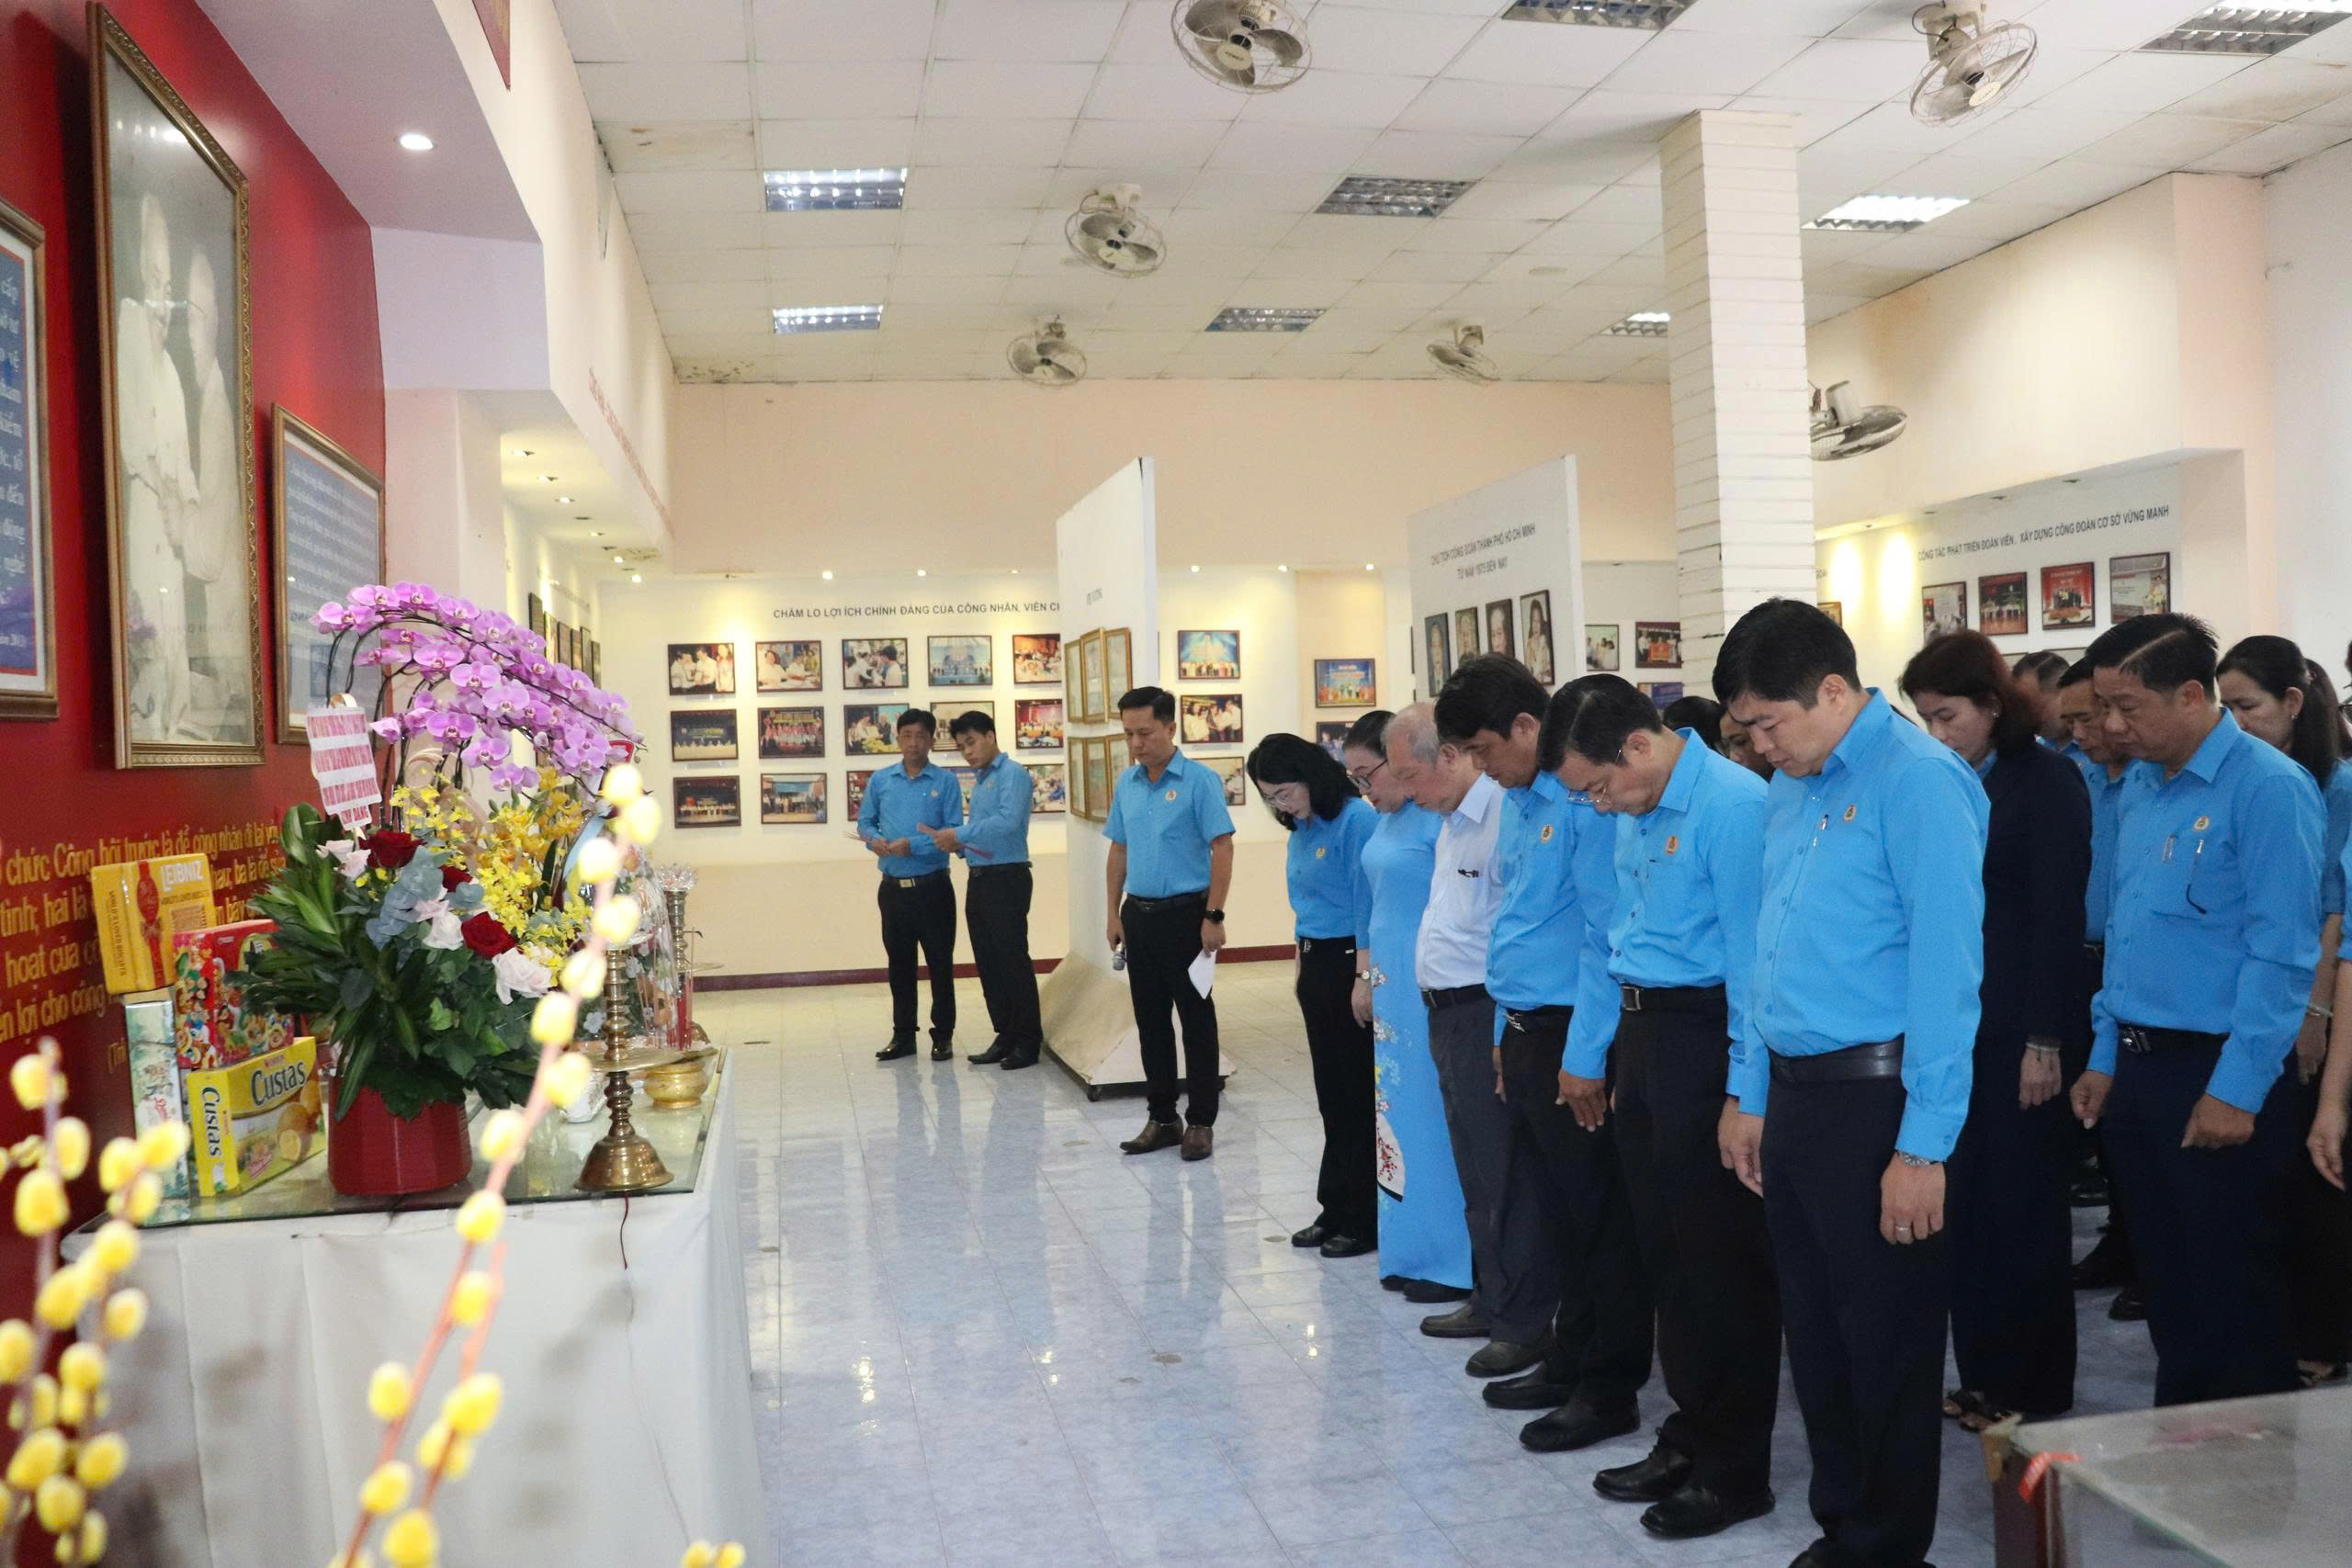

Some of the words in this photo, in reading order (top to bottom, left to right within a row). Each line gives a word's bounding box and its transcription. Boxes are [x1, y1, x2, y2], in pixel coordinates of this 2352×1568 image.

[2054, 522, 2074, 537] CÔNG
[2075, 517, 2095, 533] ĐOÀN
[807, 608, 821, 617] LO
[865, 604, 897, 616] CHÍNH
[899, 604, 930, 615] ĐÁNG
[956, 603, 987, 614] CÔNG
[1023, 601, 1046, 612] VIÊN
[161, 860, 204, 892] LEIBNIZ
[251, 1061, 306, 1106] Custas
[201, 1087, 221, 1157] Custas
